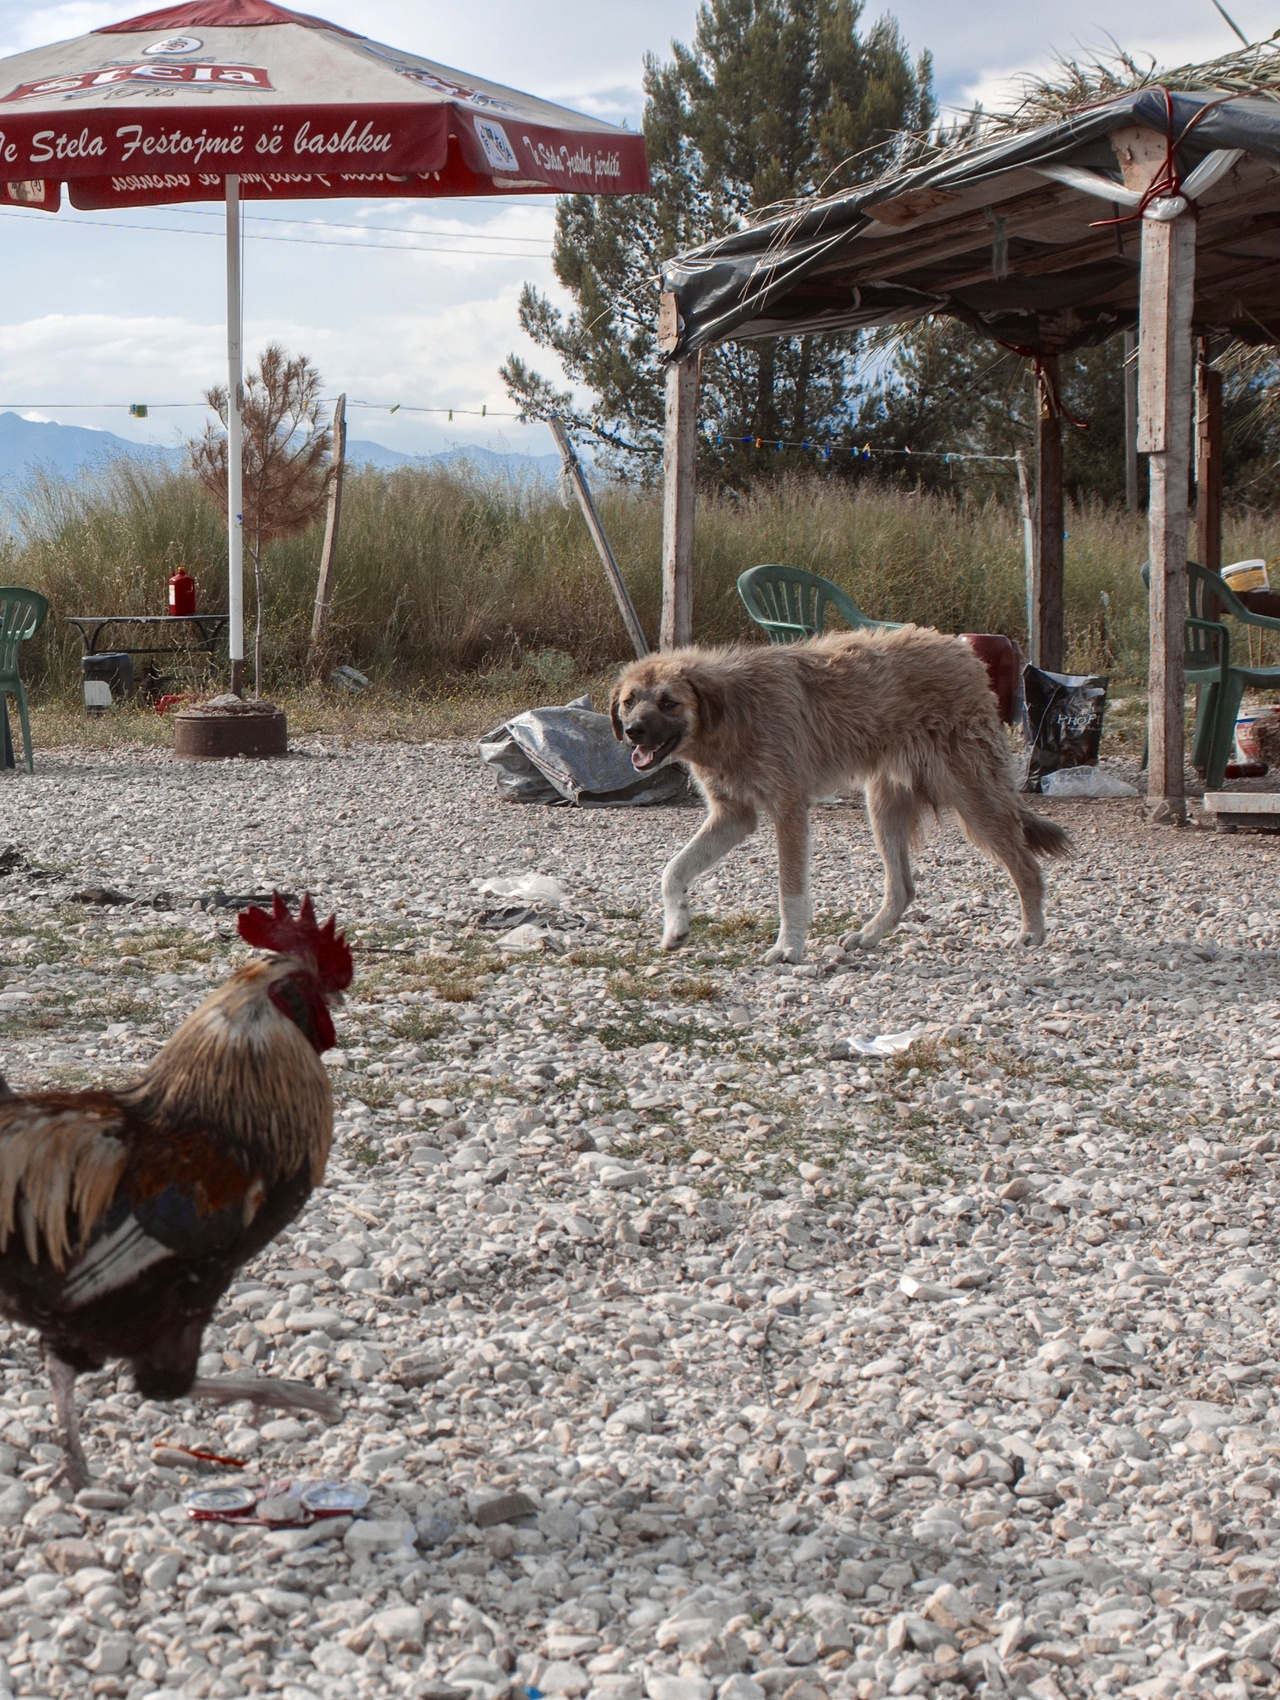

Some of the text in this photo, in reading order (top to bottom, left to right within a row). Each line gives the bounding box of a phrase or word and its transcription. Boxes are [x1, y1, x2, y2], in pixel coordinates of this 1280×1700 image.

[29, 127, 108, 163] Stela
[255, 124, 284, 154] së
[293, 120, 392, 154] bashku
